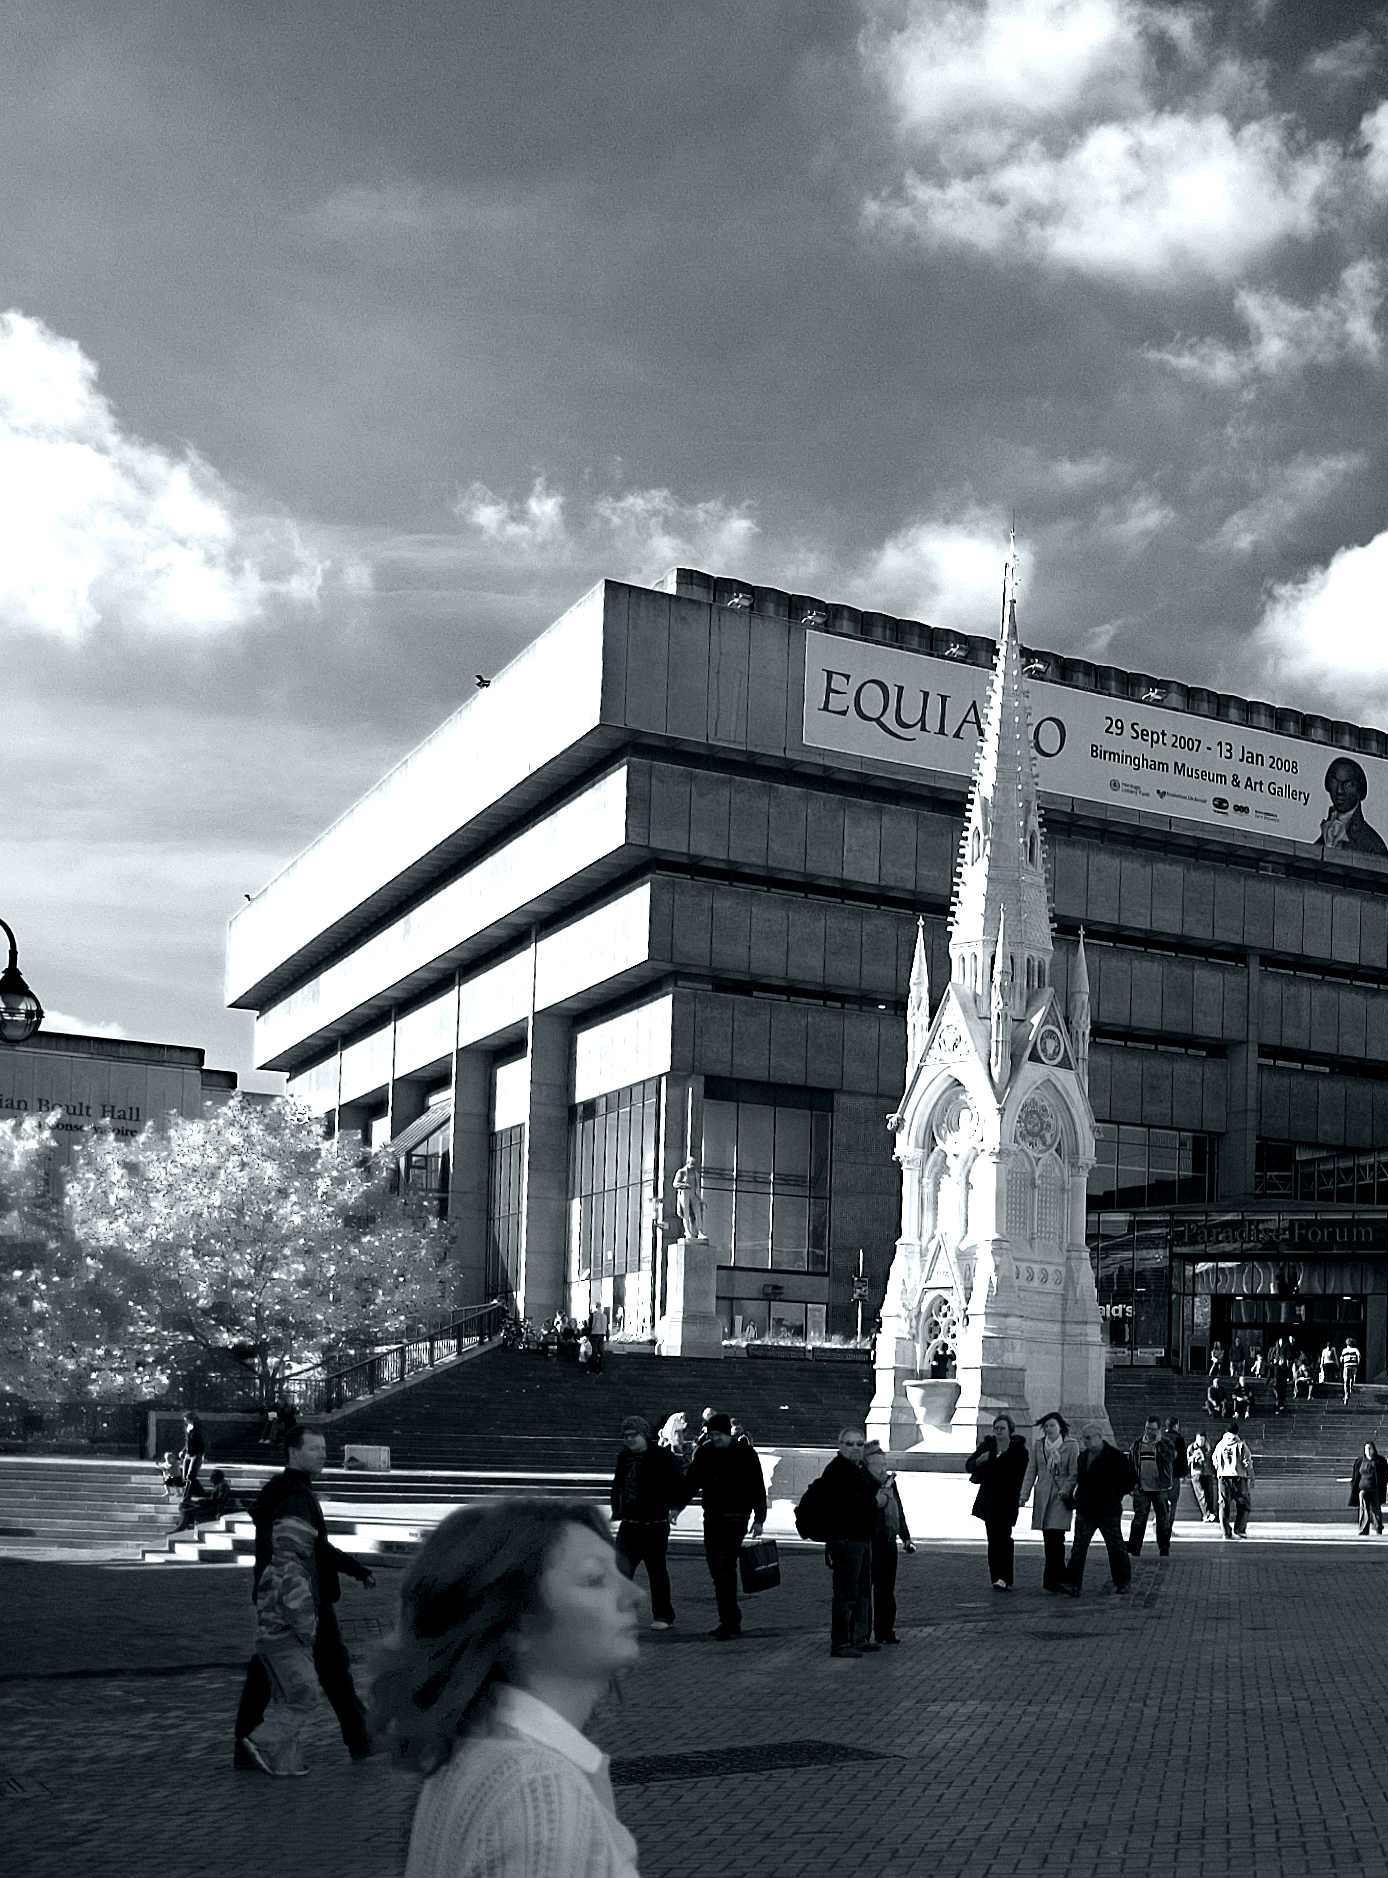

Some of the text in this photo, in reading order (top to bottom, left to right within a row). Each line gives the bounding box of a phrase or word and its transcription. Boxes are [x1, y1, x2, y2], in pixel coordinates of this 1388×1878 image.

[817, 668, 1067, 758] EQUIAO
[1104, 716, 1125, 736] 29
[1130, 722, 1168, 748] Sept
[1171, 734, 1202, 753] 2007
[1216, 741, 1233, 759] 13
[1239, 746, 1265, 767] Jan
[1269, 755, 1299, 774] 2008
[1090, 744, 1310, 806] Birmingham Museum & Art Gallery
[101, 1103, 141, 1122] Hall
[1294, 1220, 1374, 1243] Forum
